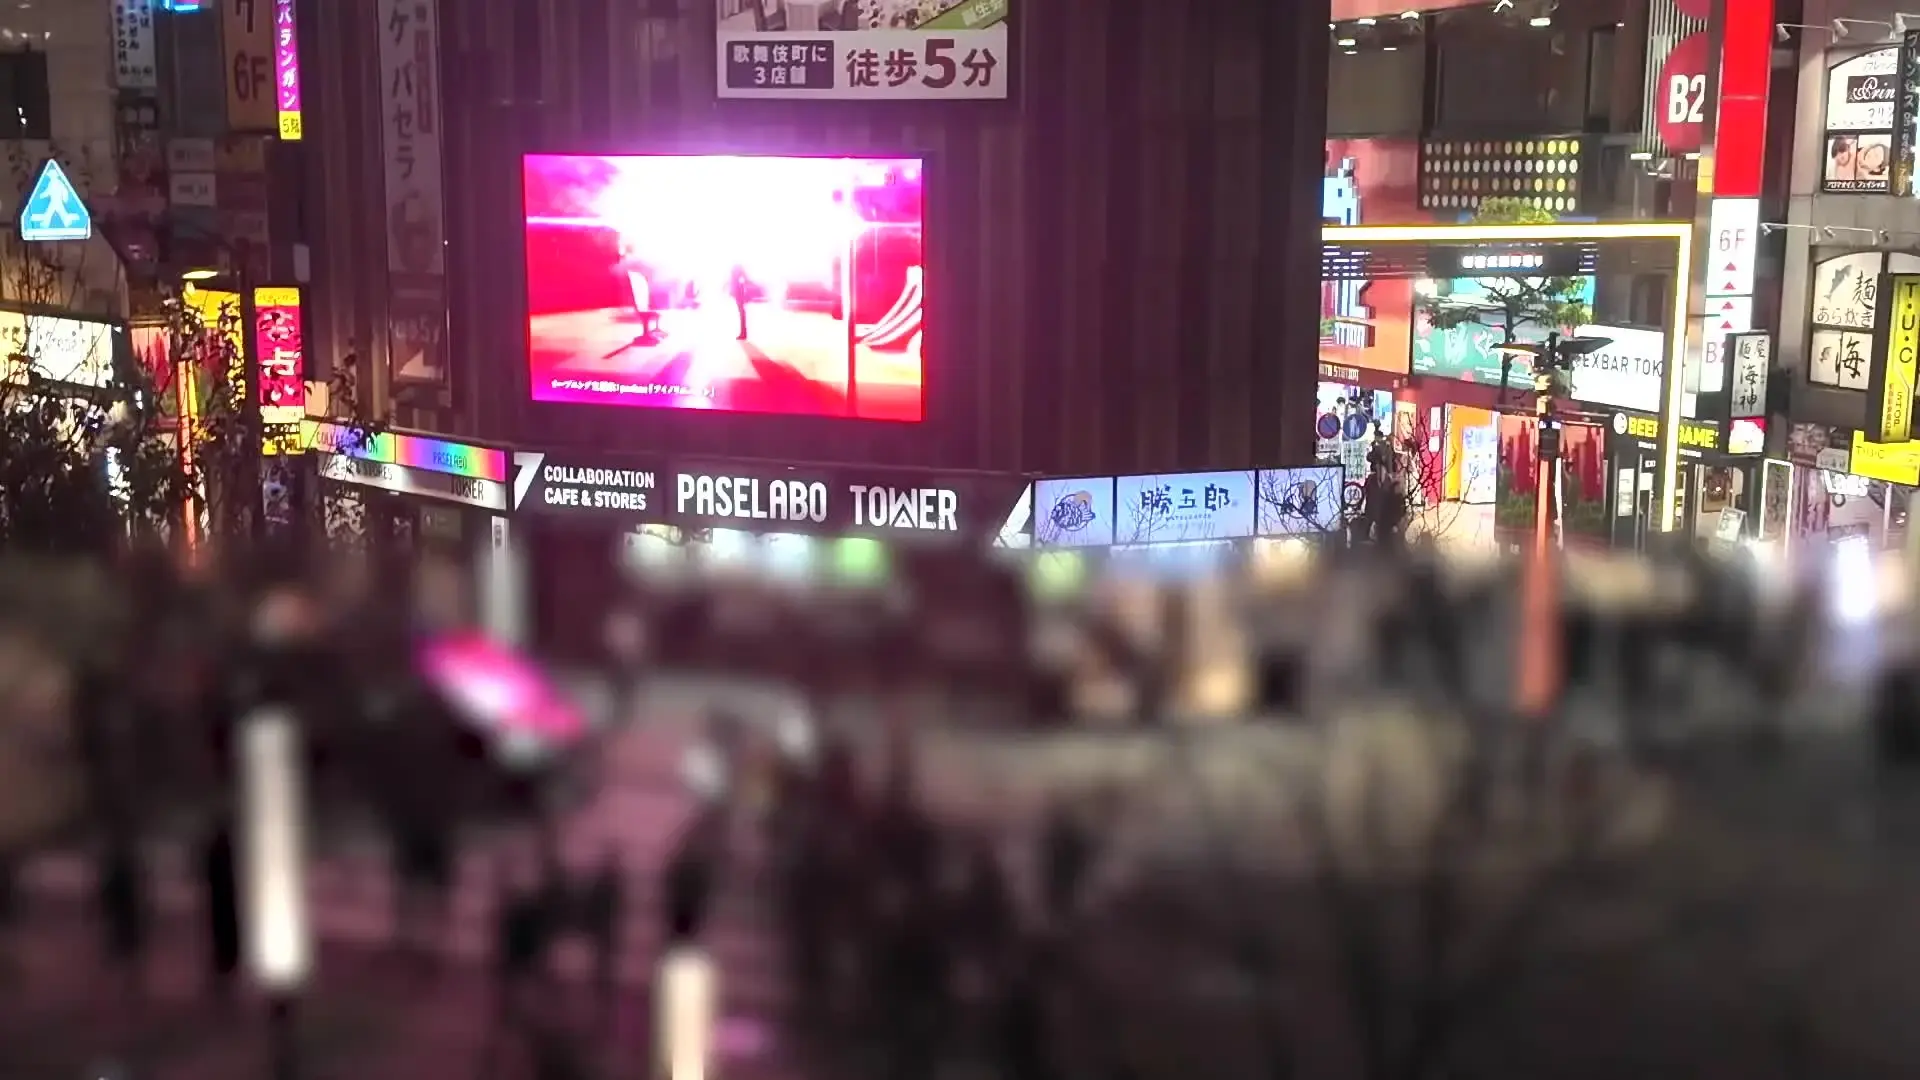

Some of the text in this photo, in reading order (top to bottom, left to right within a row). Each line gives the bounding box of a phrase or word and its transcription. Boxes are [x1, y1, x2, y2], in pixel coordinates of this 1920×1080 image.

[278, 0, 296, 108] バランガン
[732, 44, 827, 62] 歌舞伎町に
[846, 38, 997, 89] 徒歩5分
[234, 52, 268, 100] 6F
[1668, 74, 1706, 123] B2
[1719, 227, 1748, 252] 6F
[544, 466, 655, 489] COLLABORATION
[544, 487, 647, 512] CAFE & STORES
[677, 473, 958, 531] PASELABO TOWER
[1140, 482, 1230, 515] 勝五郎
